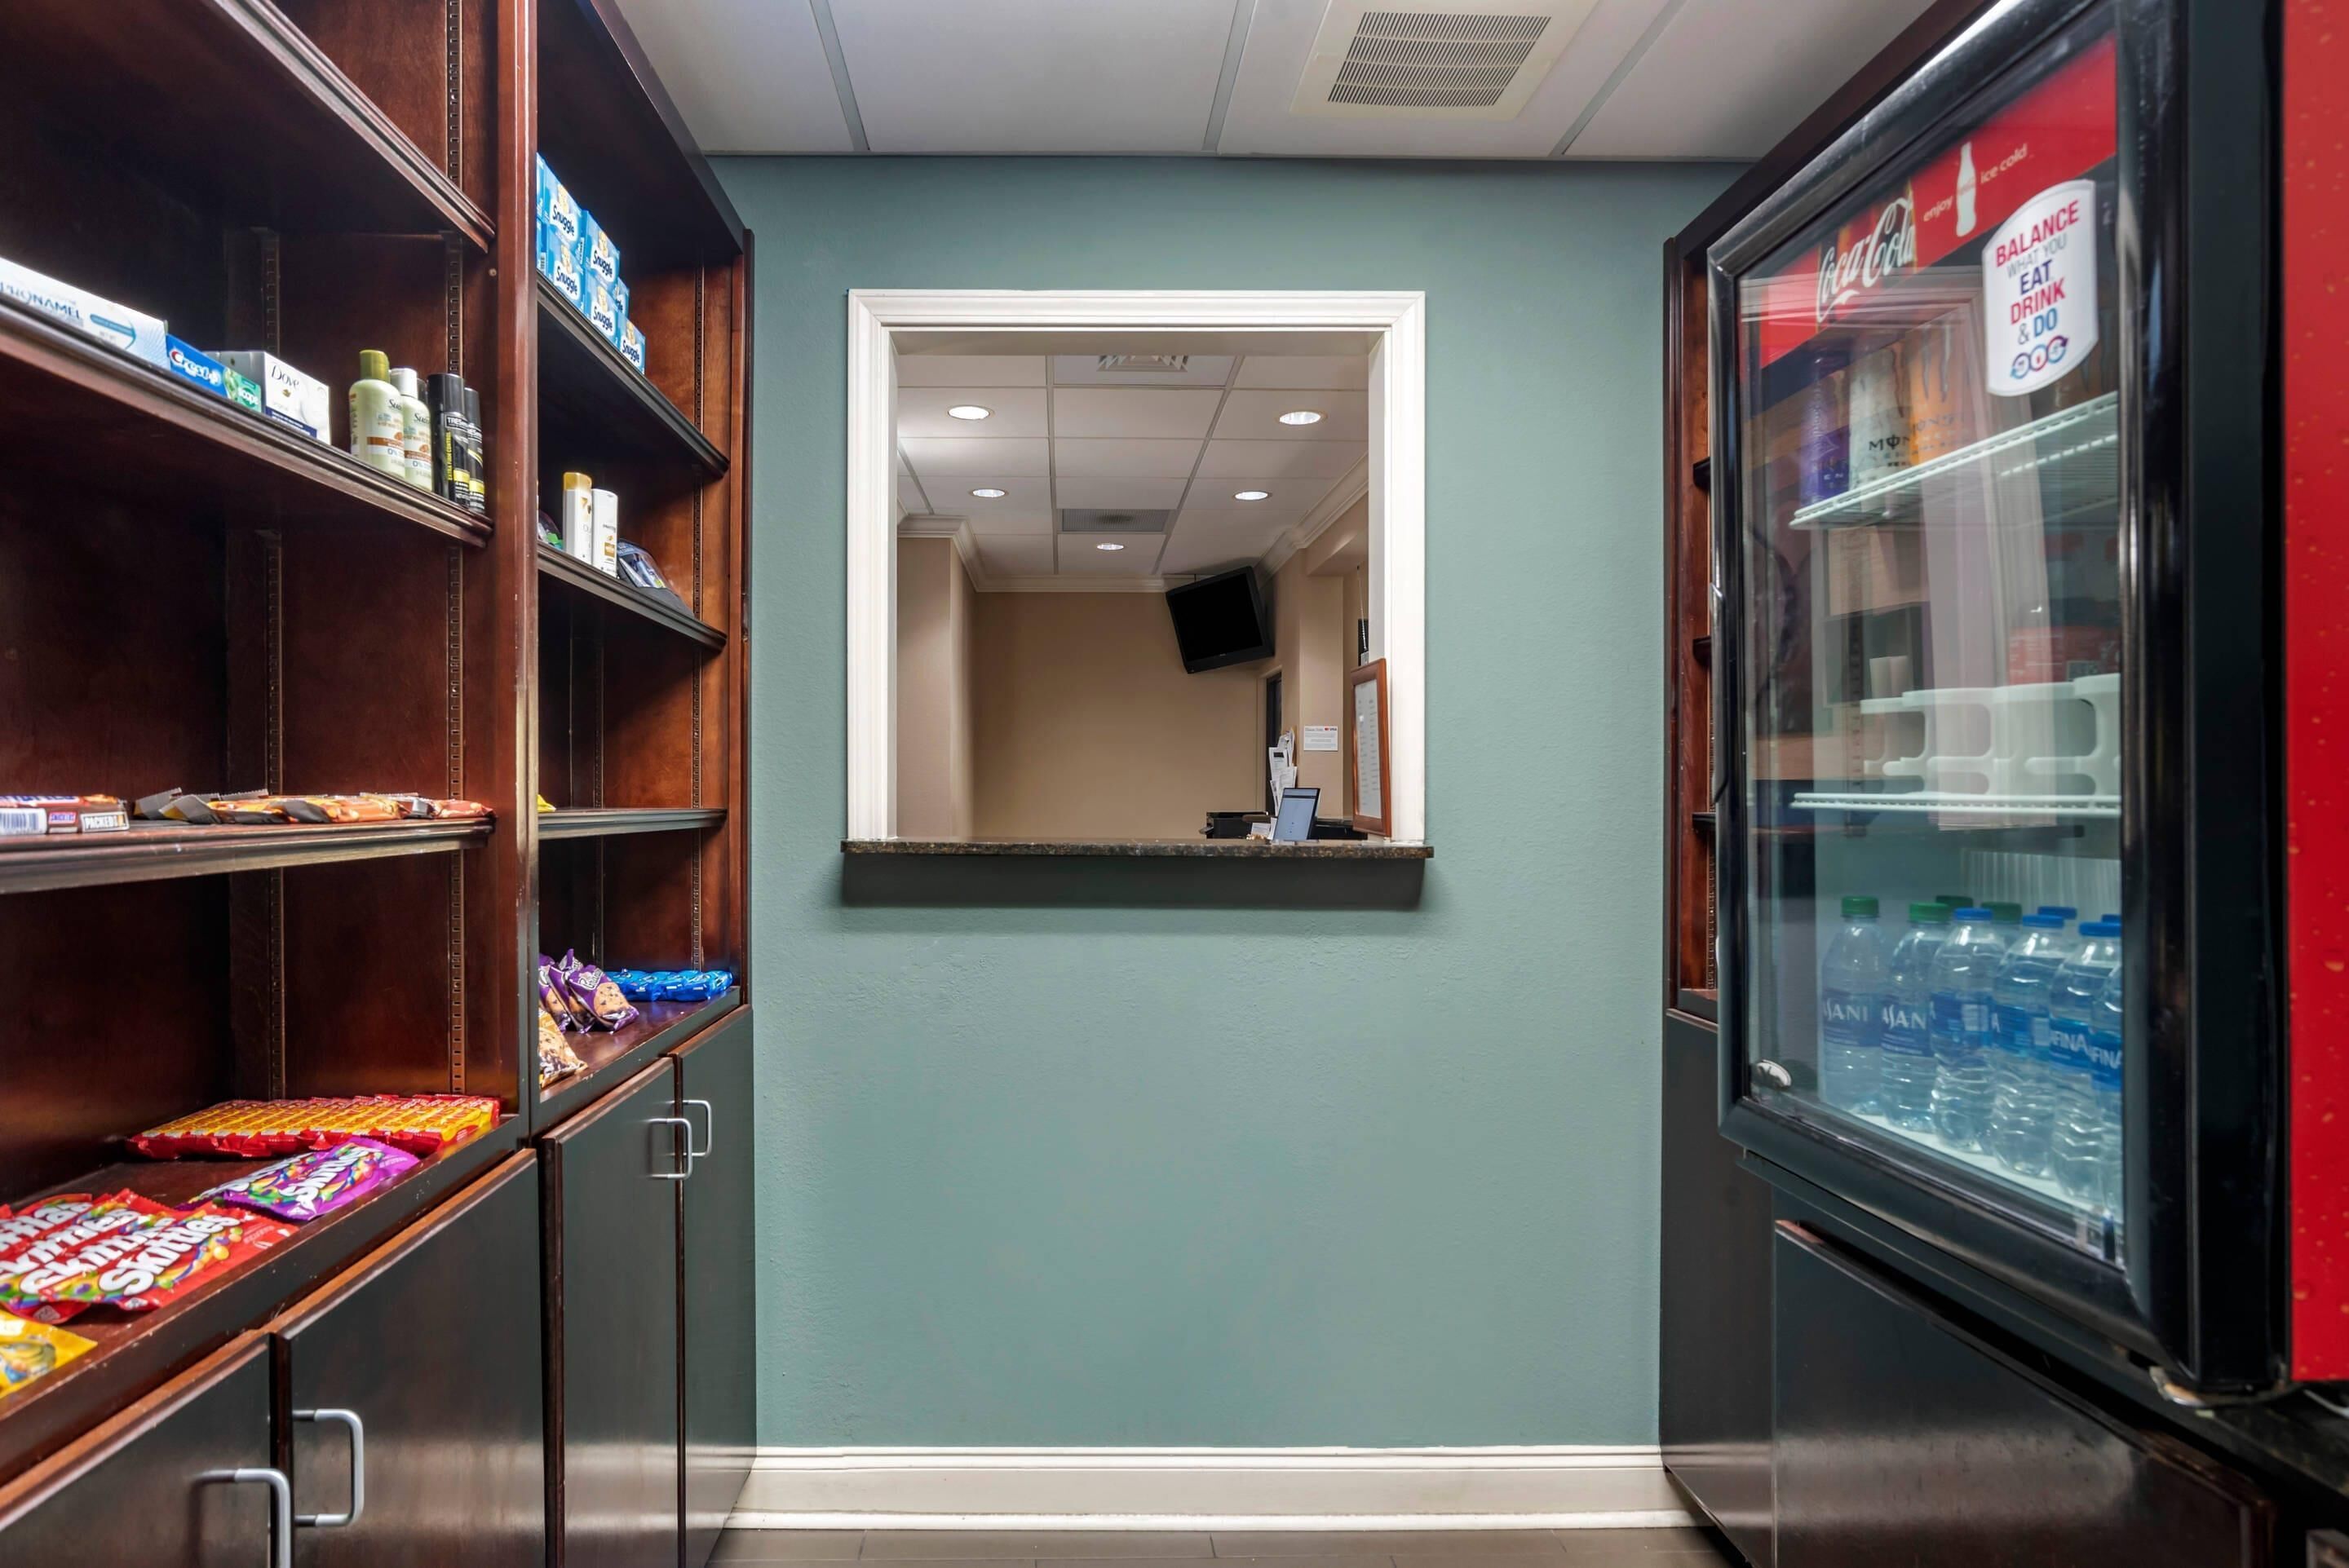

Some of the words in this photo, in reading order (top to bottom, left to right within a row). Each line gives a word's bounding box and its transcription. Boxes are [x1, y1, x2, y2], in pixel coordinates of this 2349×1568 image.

[1923, 196, 1953, 222] enjoy
[1980, 166, 1998, 184] ice
[2000, 143, 2028, 171] cold
[552, 205, 575, 236] Snuggle
[1996, 199, 2080, 267] BALANCE
[593, 250, 613, 278] Snuggle
[2007, 248, 2038, 278] WHAT
[2042, 232, 2067, 258] YOU
[556, 266, 578, 296] Snuggle
[2020, 258, 2052, 295] EAT
[593, 306, 613, 332] Snuggle
[2011, 277, 2066, 325] DRINK
[2017, 323, 2030, 345] &
[2033, 307, 2058, 338] DO
[622, 340, 640, 363] Snuggle
[272, 365, 299, 390] Dove
[99, 1214, 241, 1296] Skittles
